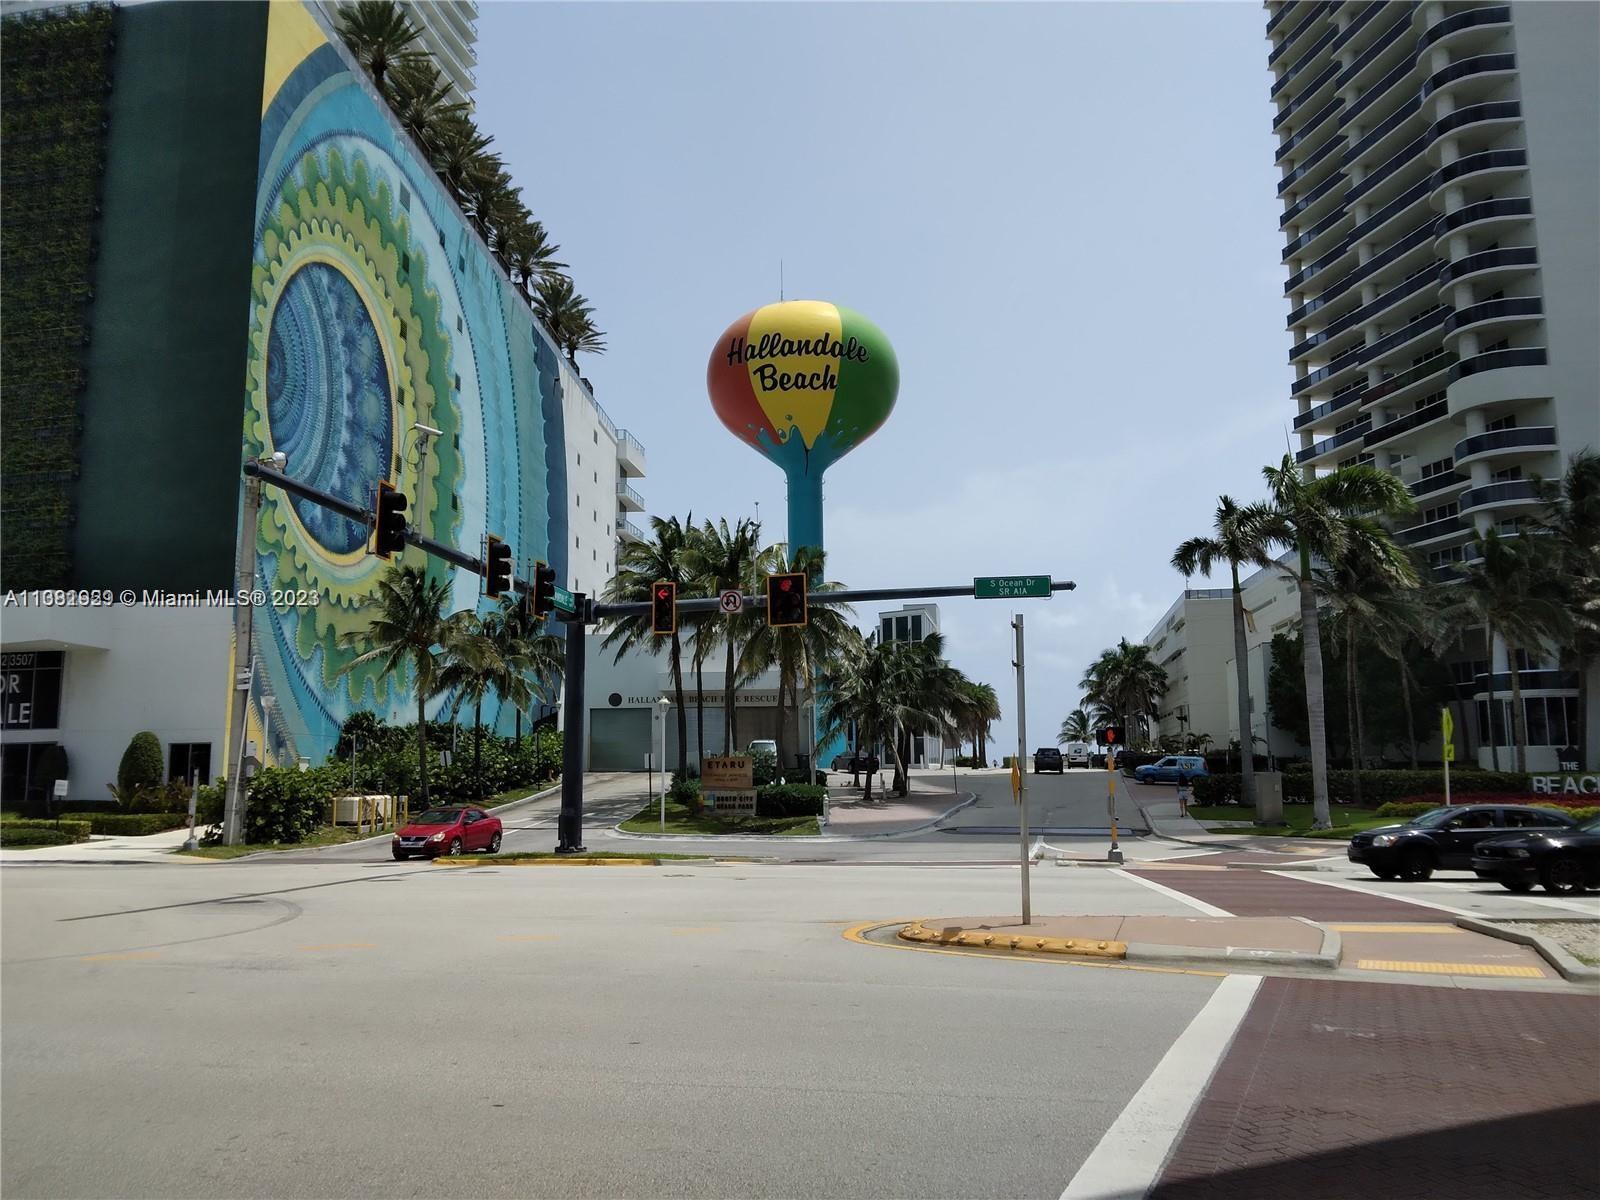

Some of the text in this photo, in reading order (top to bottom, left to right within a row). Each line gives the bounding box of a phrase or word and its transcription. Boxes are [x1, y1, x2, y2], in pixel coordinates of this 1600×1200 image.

[727, 332, 869, 366] Hallandale
[753, 363, 837, 391] Beach
[999, 579, 1023, 587] Ocean
[1026, 578, 1035, 586] Dr
[999, 588, 1010, 596] SR
[744, 695, 778, 703] RESCUE
[0, 702, 31, 724] LE
[707, 760, 745, 769] ETARU
[1560, 761, 1580, 771] THE
[1532, 775, 1600, 795] BEAC
